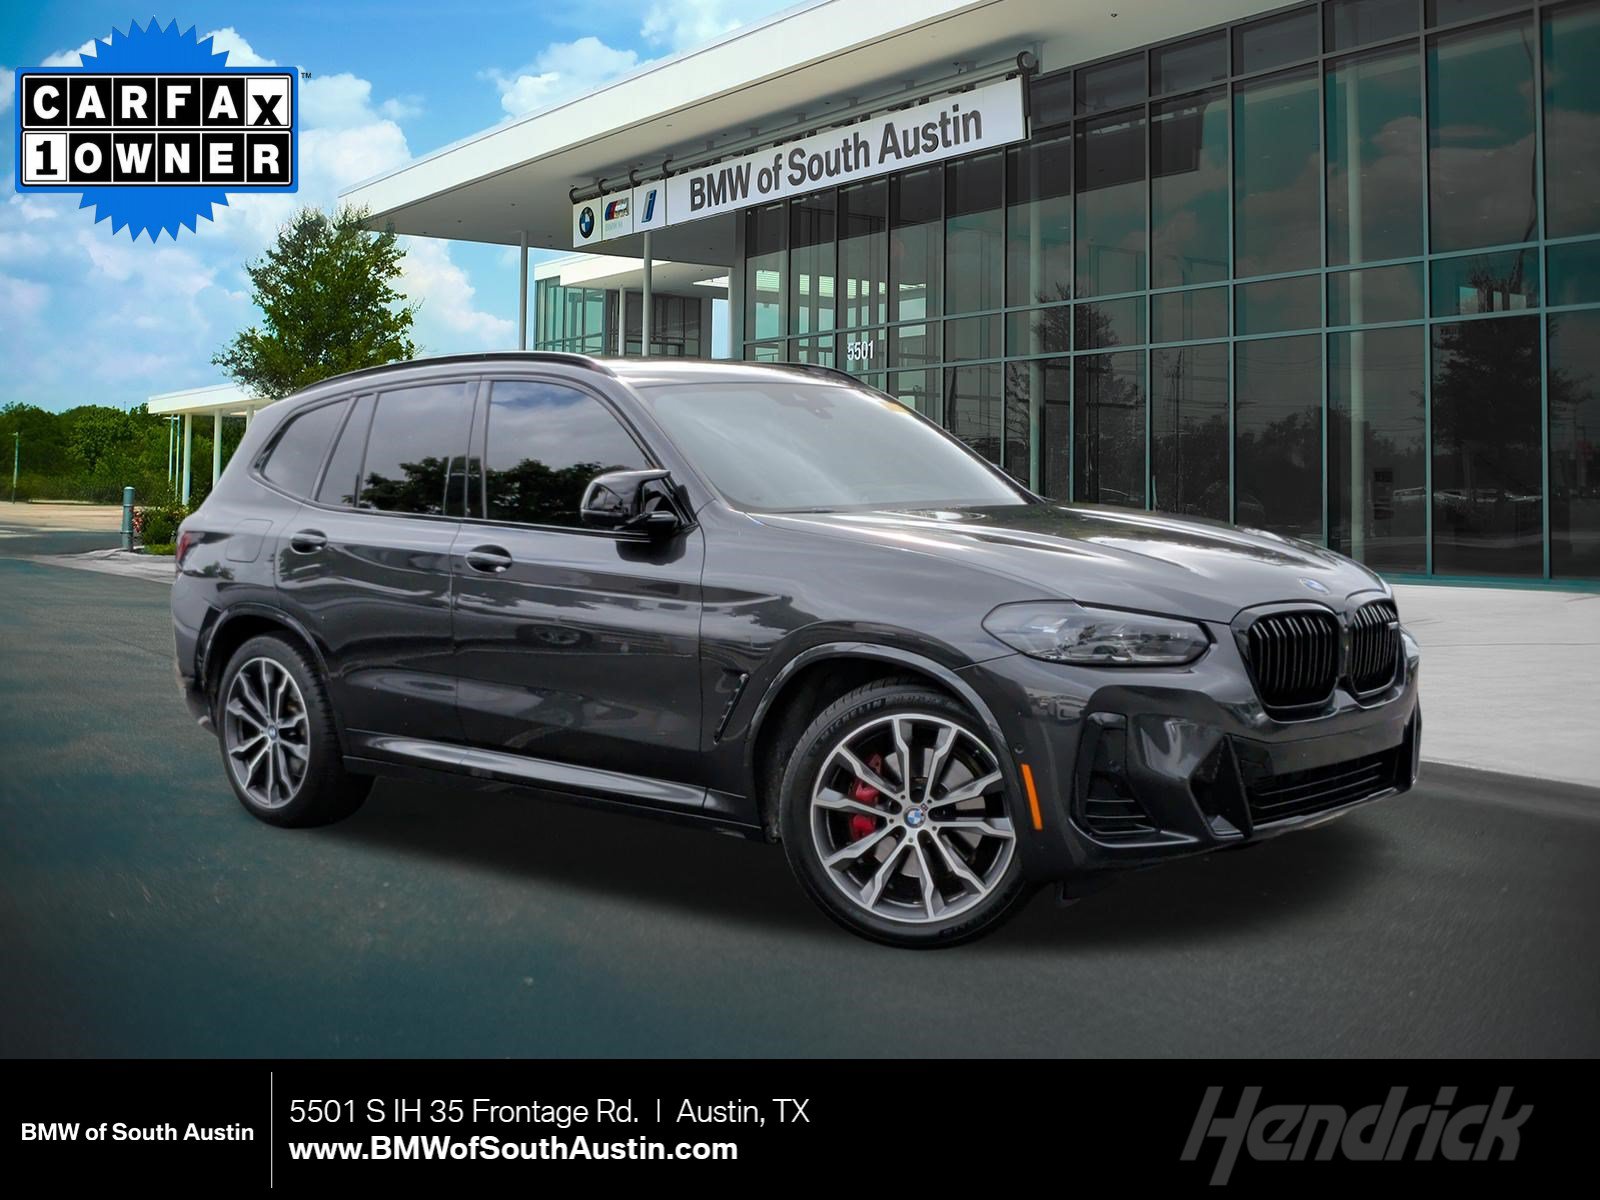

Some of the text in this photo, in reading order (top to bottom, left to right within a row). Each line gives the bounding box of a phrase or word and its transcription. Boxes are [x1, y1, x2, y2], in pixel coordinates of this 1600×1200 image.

[690, 103, 983, 212] BMW of South Austin
[847, 340, 875, 361] 5501
